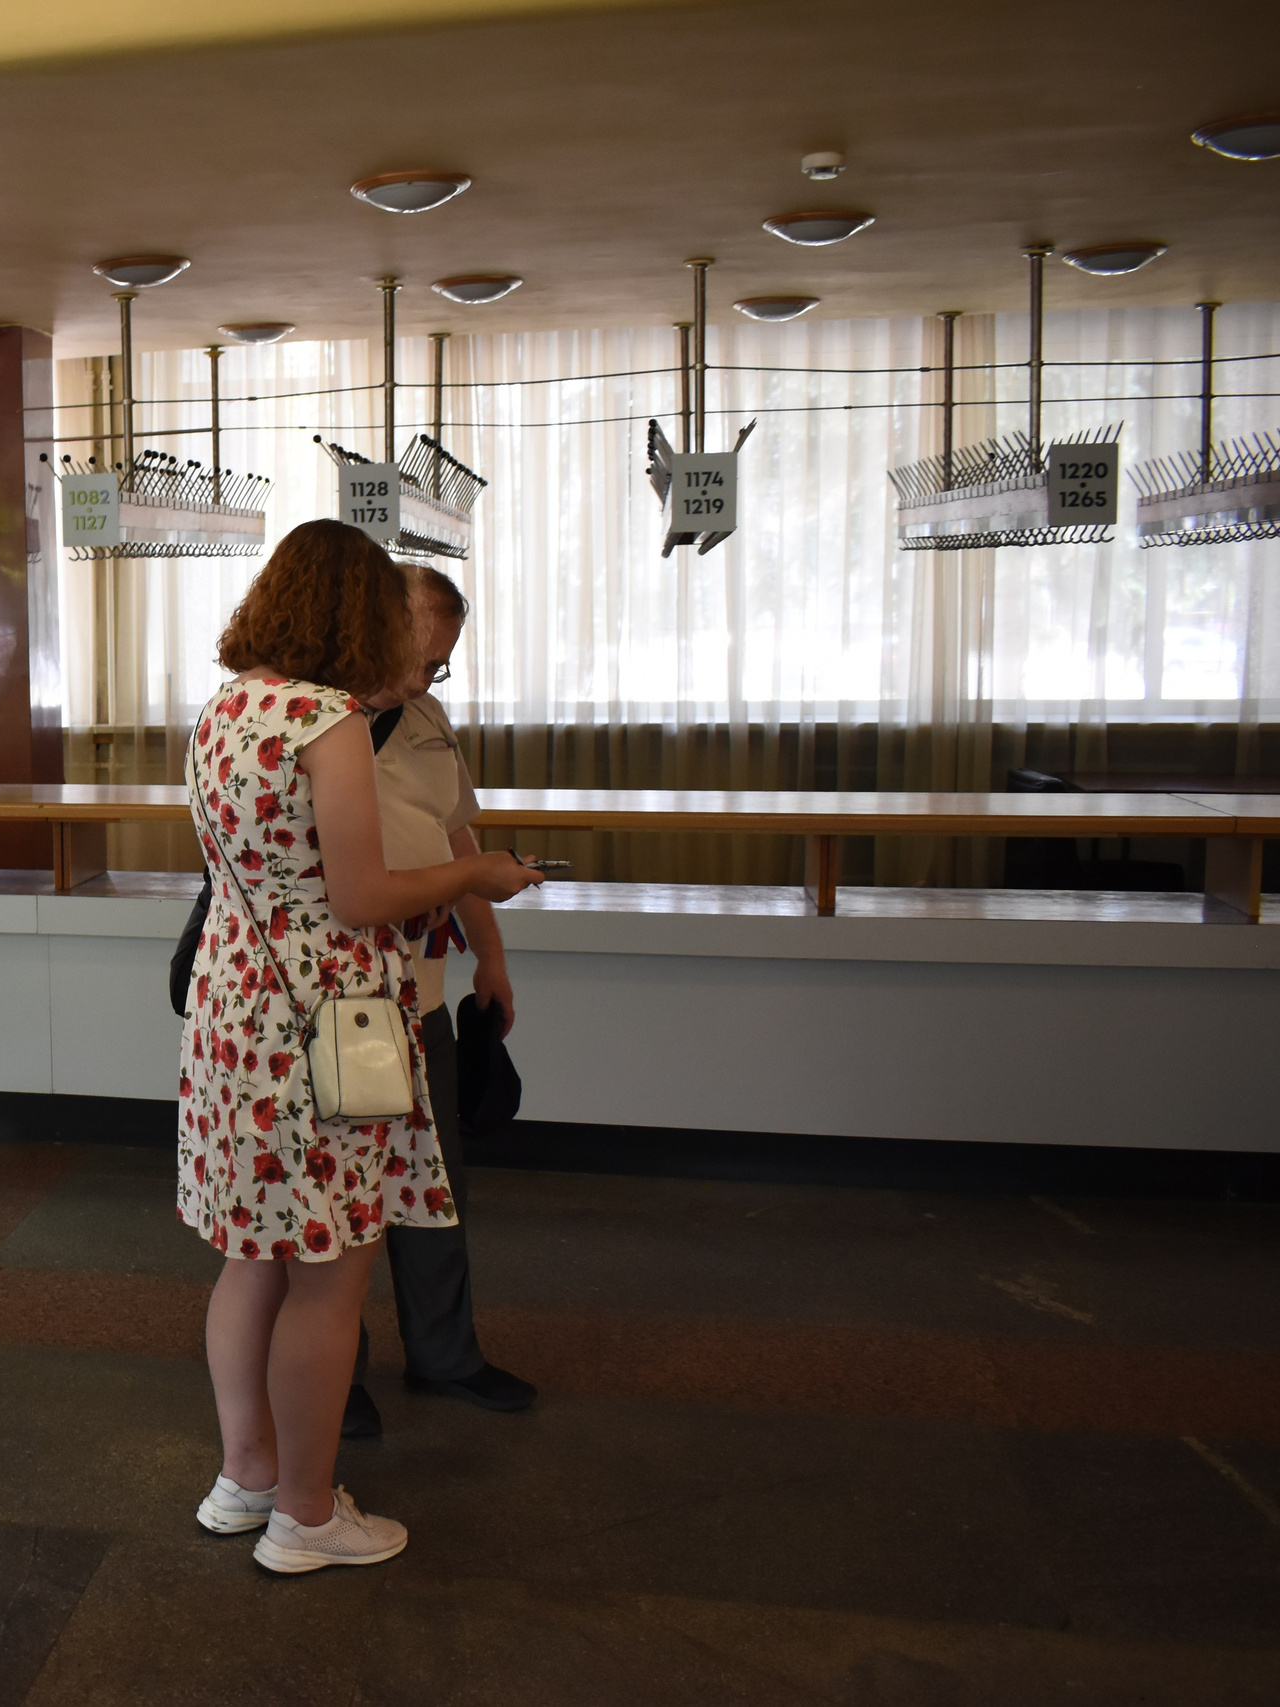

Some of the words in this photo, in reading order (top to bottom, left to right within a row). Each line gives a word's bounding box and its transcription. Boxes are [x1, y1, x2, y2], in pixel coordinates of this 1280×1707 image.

[1059, 462, 1108, 479] 1220
[685, 471, 724, 487] 1174
[350, 481, 389, 497] 1128
[69, 489, 110, 506] 1082
[1059, 491, 1107, 508] 1265
[683, 498, 724, 515] 1219
[73, 515, 107, 531] 1127
[351, 507, 389, 523] 1173
